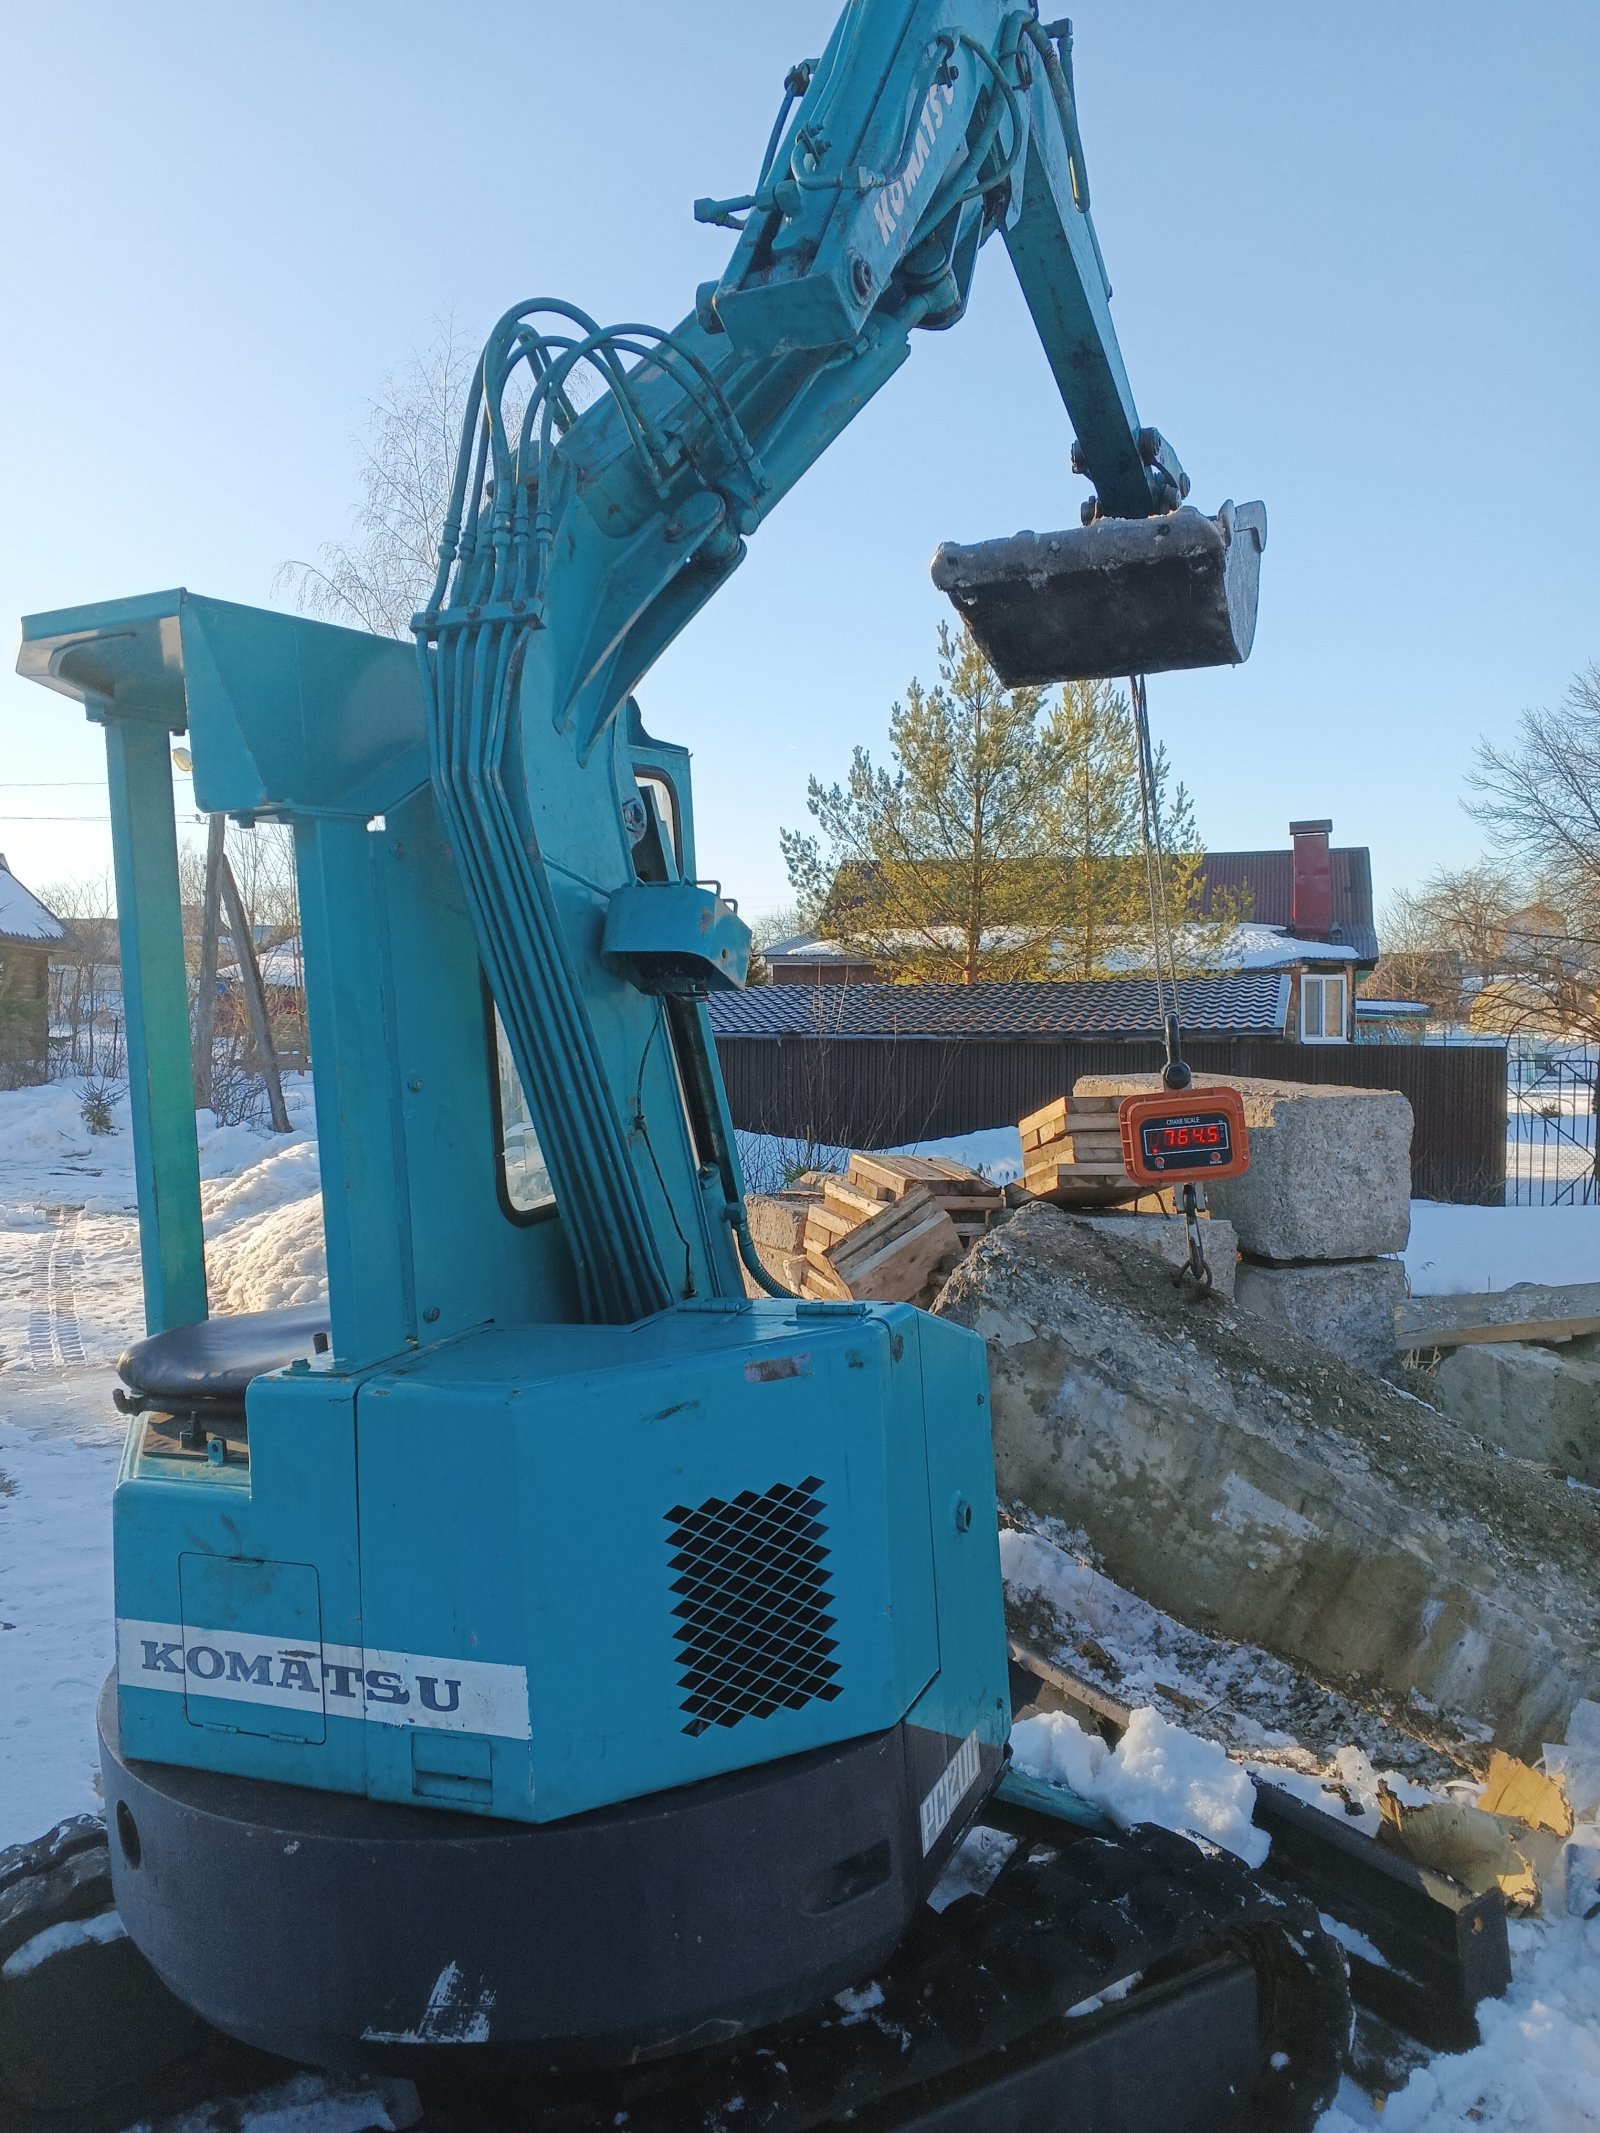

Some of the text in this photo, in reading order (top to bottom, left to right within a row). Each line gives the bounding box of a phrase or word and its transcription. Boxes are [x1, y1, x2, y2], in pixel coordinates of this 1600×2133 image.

[1166, 1116, 1200, 1126] CRANE SCALE
[1164, 1125, 1219, 1145] 764.5
[140, 1640, 461, 1712] KOMATSU
